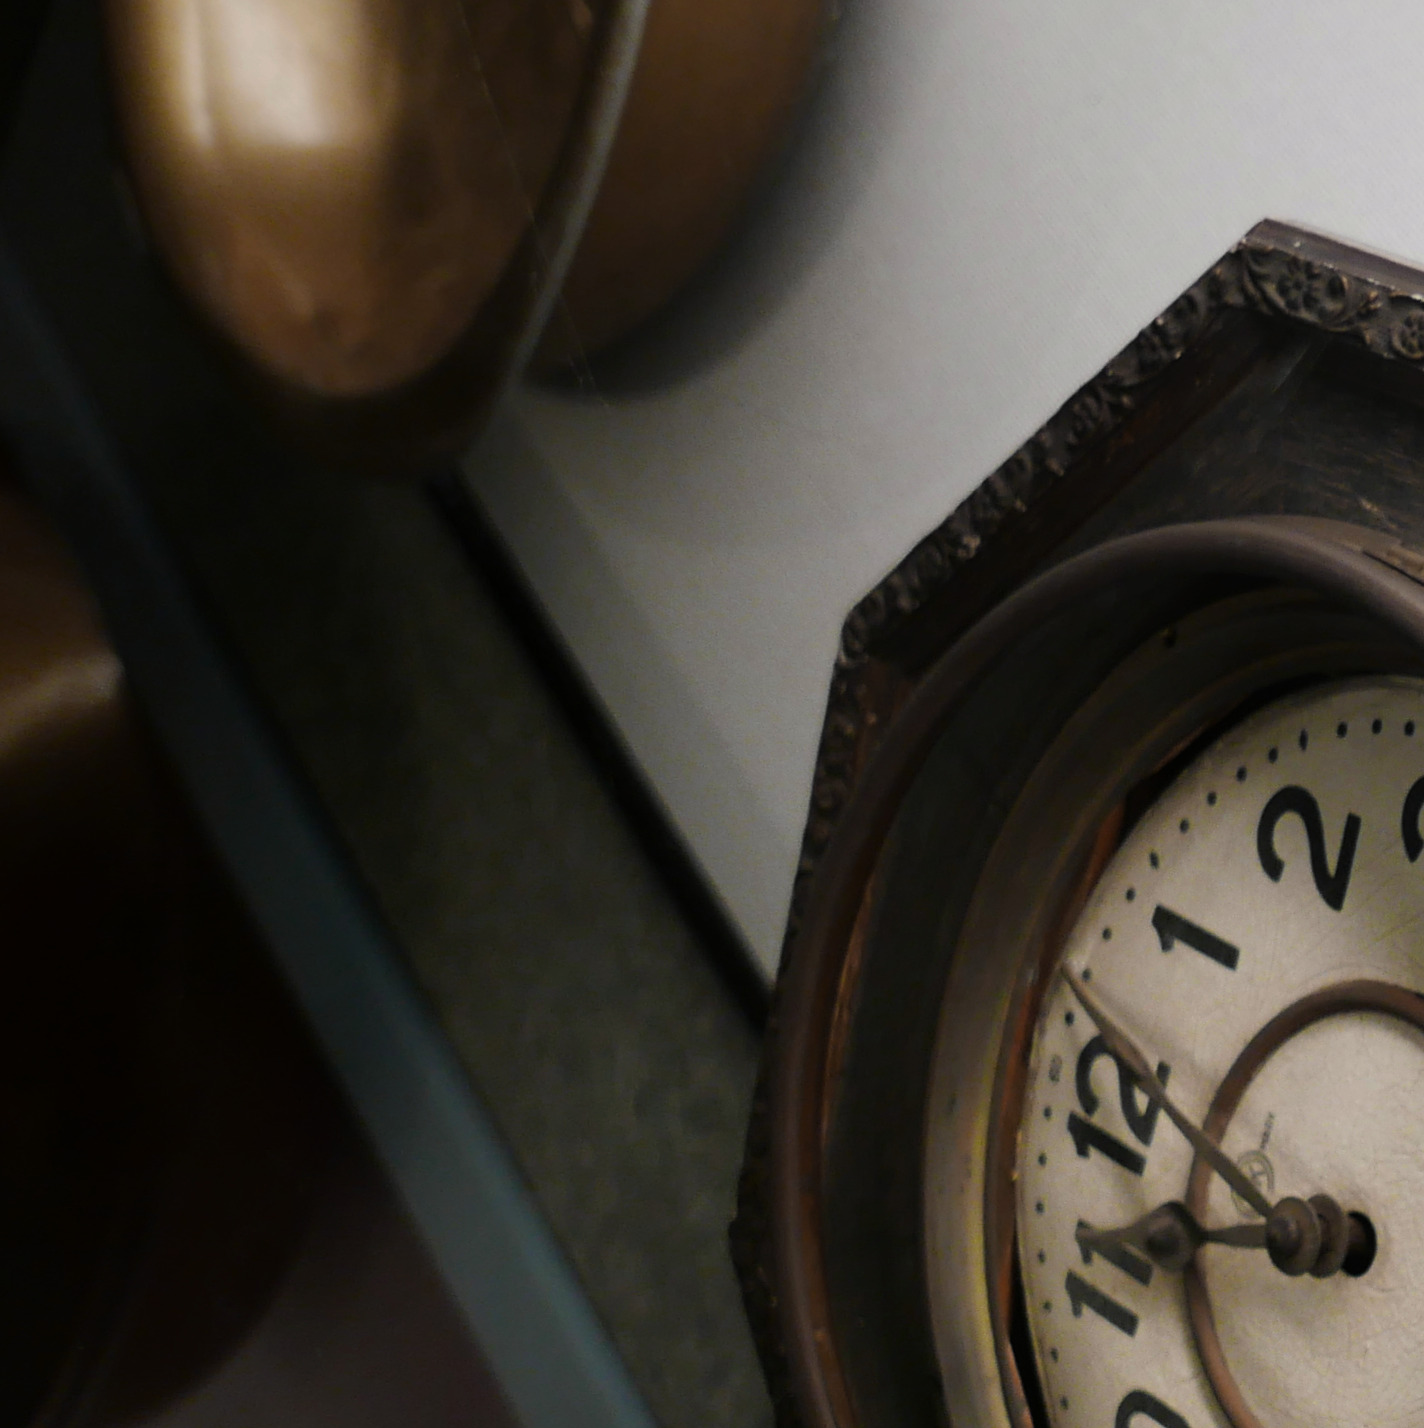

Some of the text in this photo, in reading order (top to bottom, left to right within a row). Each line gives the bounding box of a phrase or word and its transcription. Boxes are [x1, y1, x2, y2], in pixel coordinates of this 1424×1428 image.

[1256, 785, 1362, 911] 2
[1151, 904, 1239, 972] 1
[1067, 1034, 1171, 1177] 12
